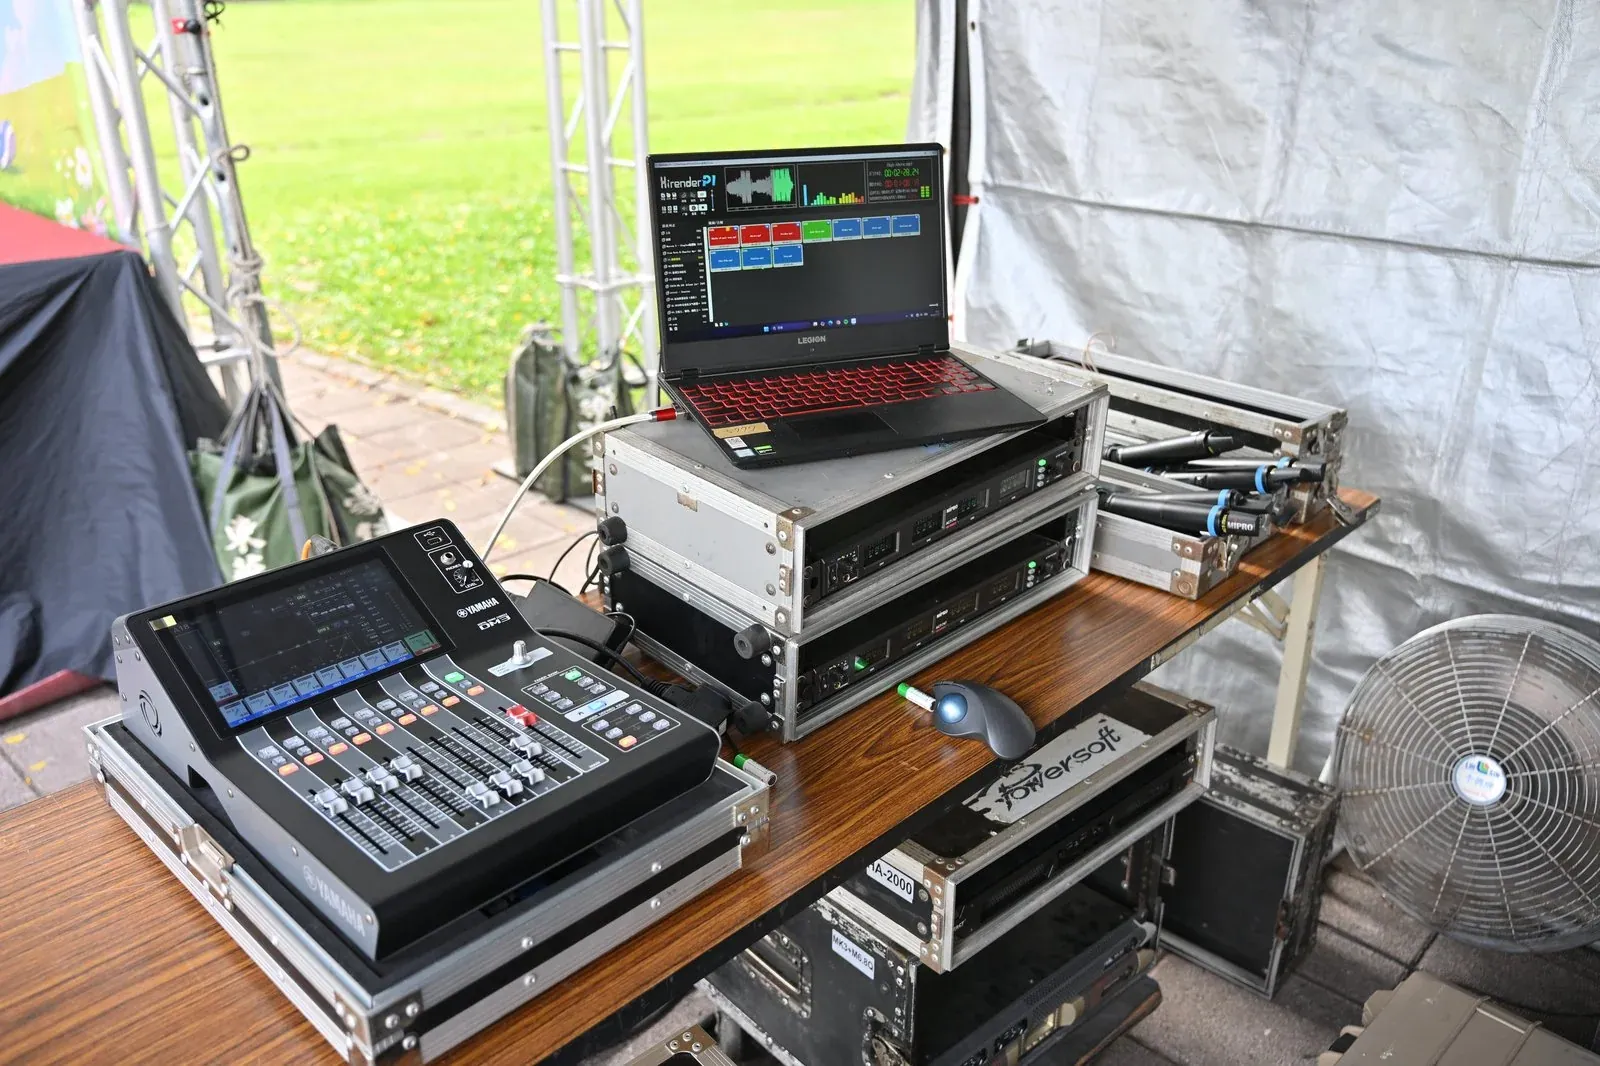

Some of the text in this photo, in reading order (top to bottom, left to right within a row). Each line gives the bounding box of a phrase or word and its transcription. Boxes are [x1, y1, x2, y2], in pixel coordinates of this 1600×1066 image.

[797, 335, 827, 345] LEGION
[1227, 521, 1254, 531] MIPRO
[465, 597, 500, 615] YAMAHA
[315, 875, 366, 937] YAMAHA
